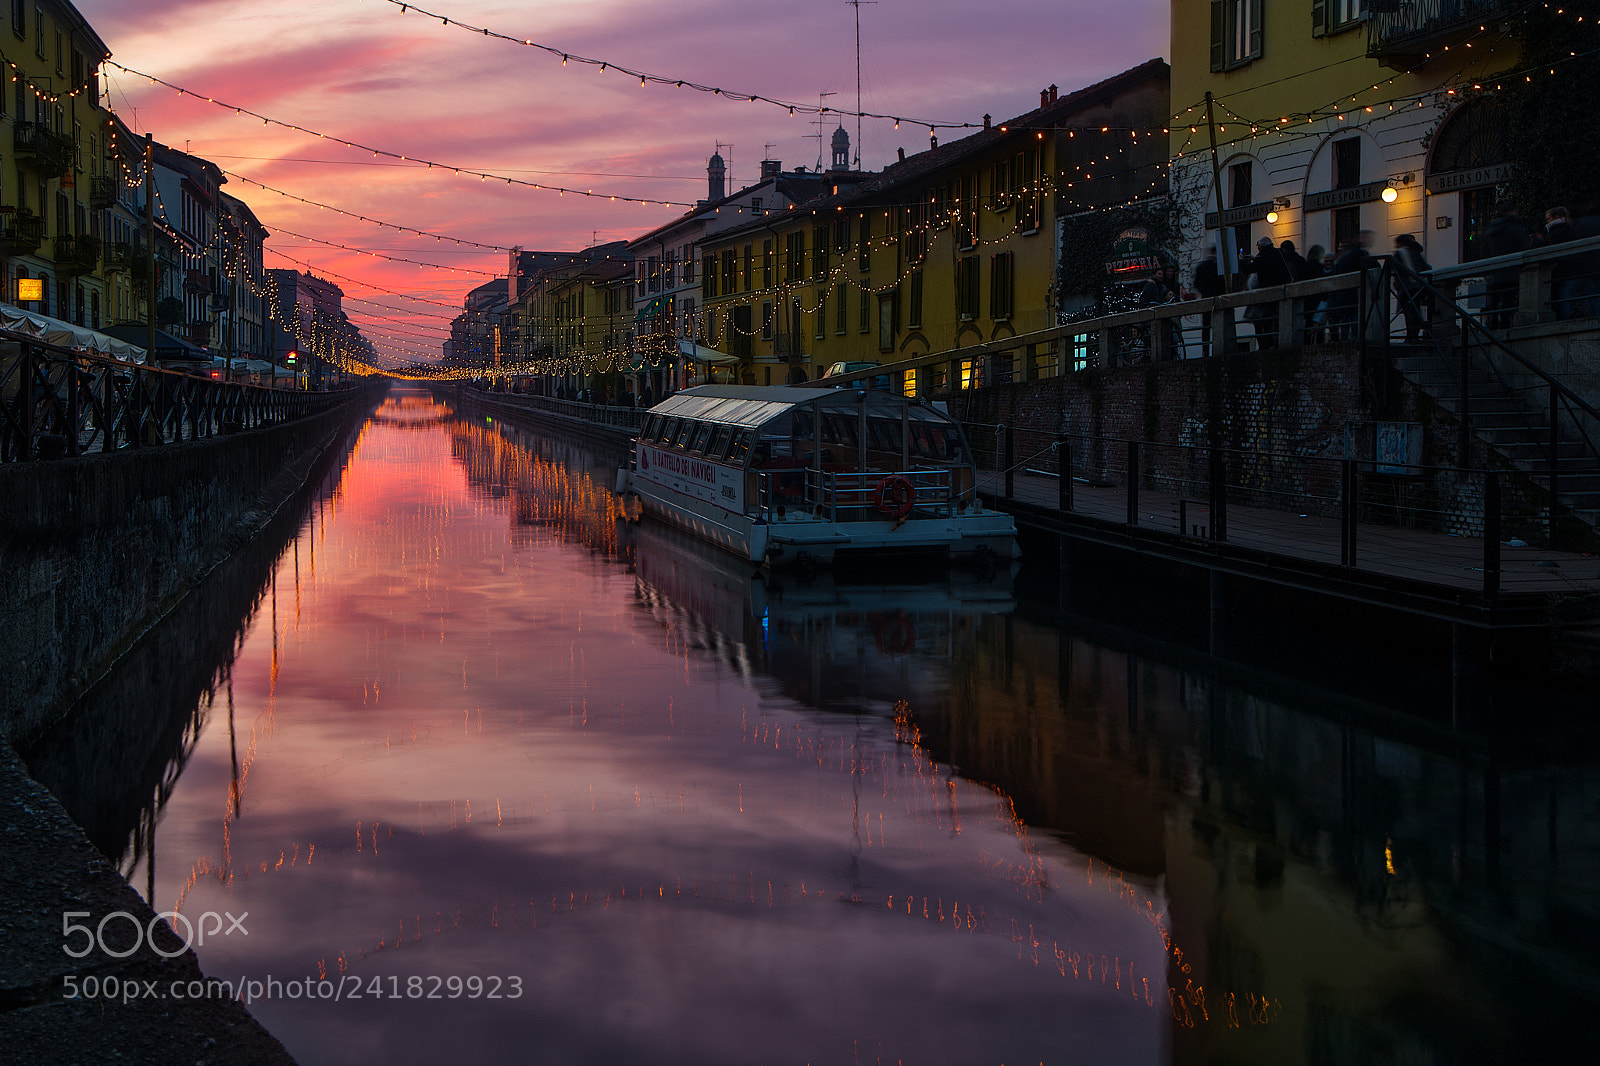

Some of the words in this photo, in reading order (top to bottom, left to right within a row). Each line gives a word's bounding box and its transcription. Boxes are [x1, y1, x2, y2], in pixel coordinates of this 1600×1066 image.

[1440, 173, 1471, 189] BEERS
[1475, 169, 1490, 182] ON
[1317, 193, 1336, 206] LIVE
[1338, 188, 1372, 203] SPORTS
[1105, 255, 1161, 275] PIZZERIA
[658, 451, 681, 473] BATTELLO
[681, 458, 690, 477] DEI
[691, 460, 716, 485] NAVIGLI
